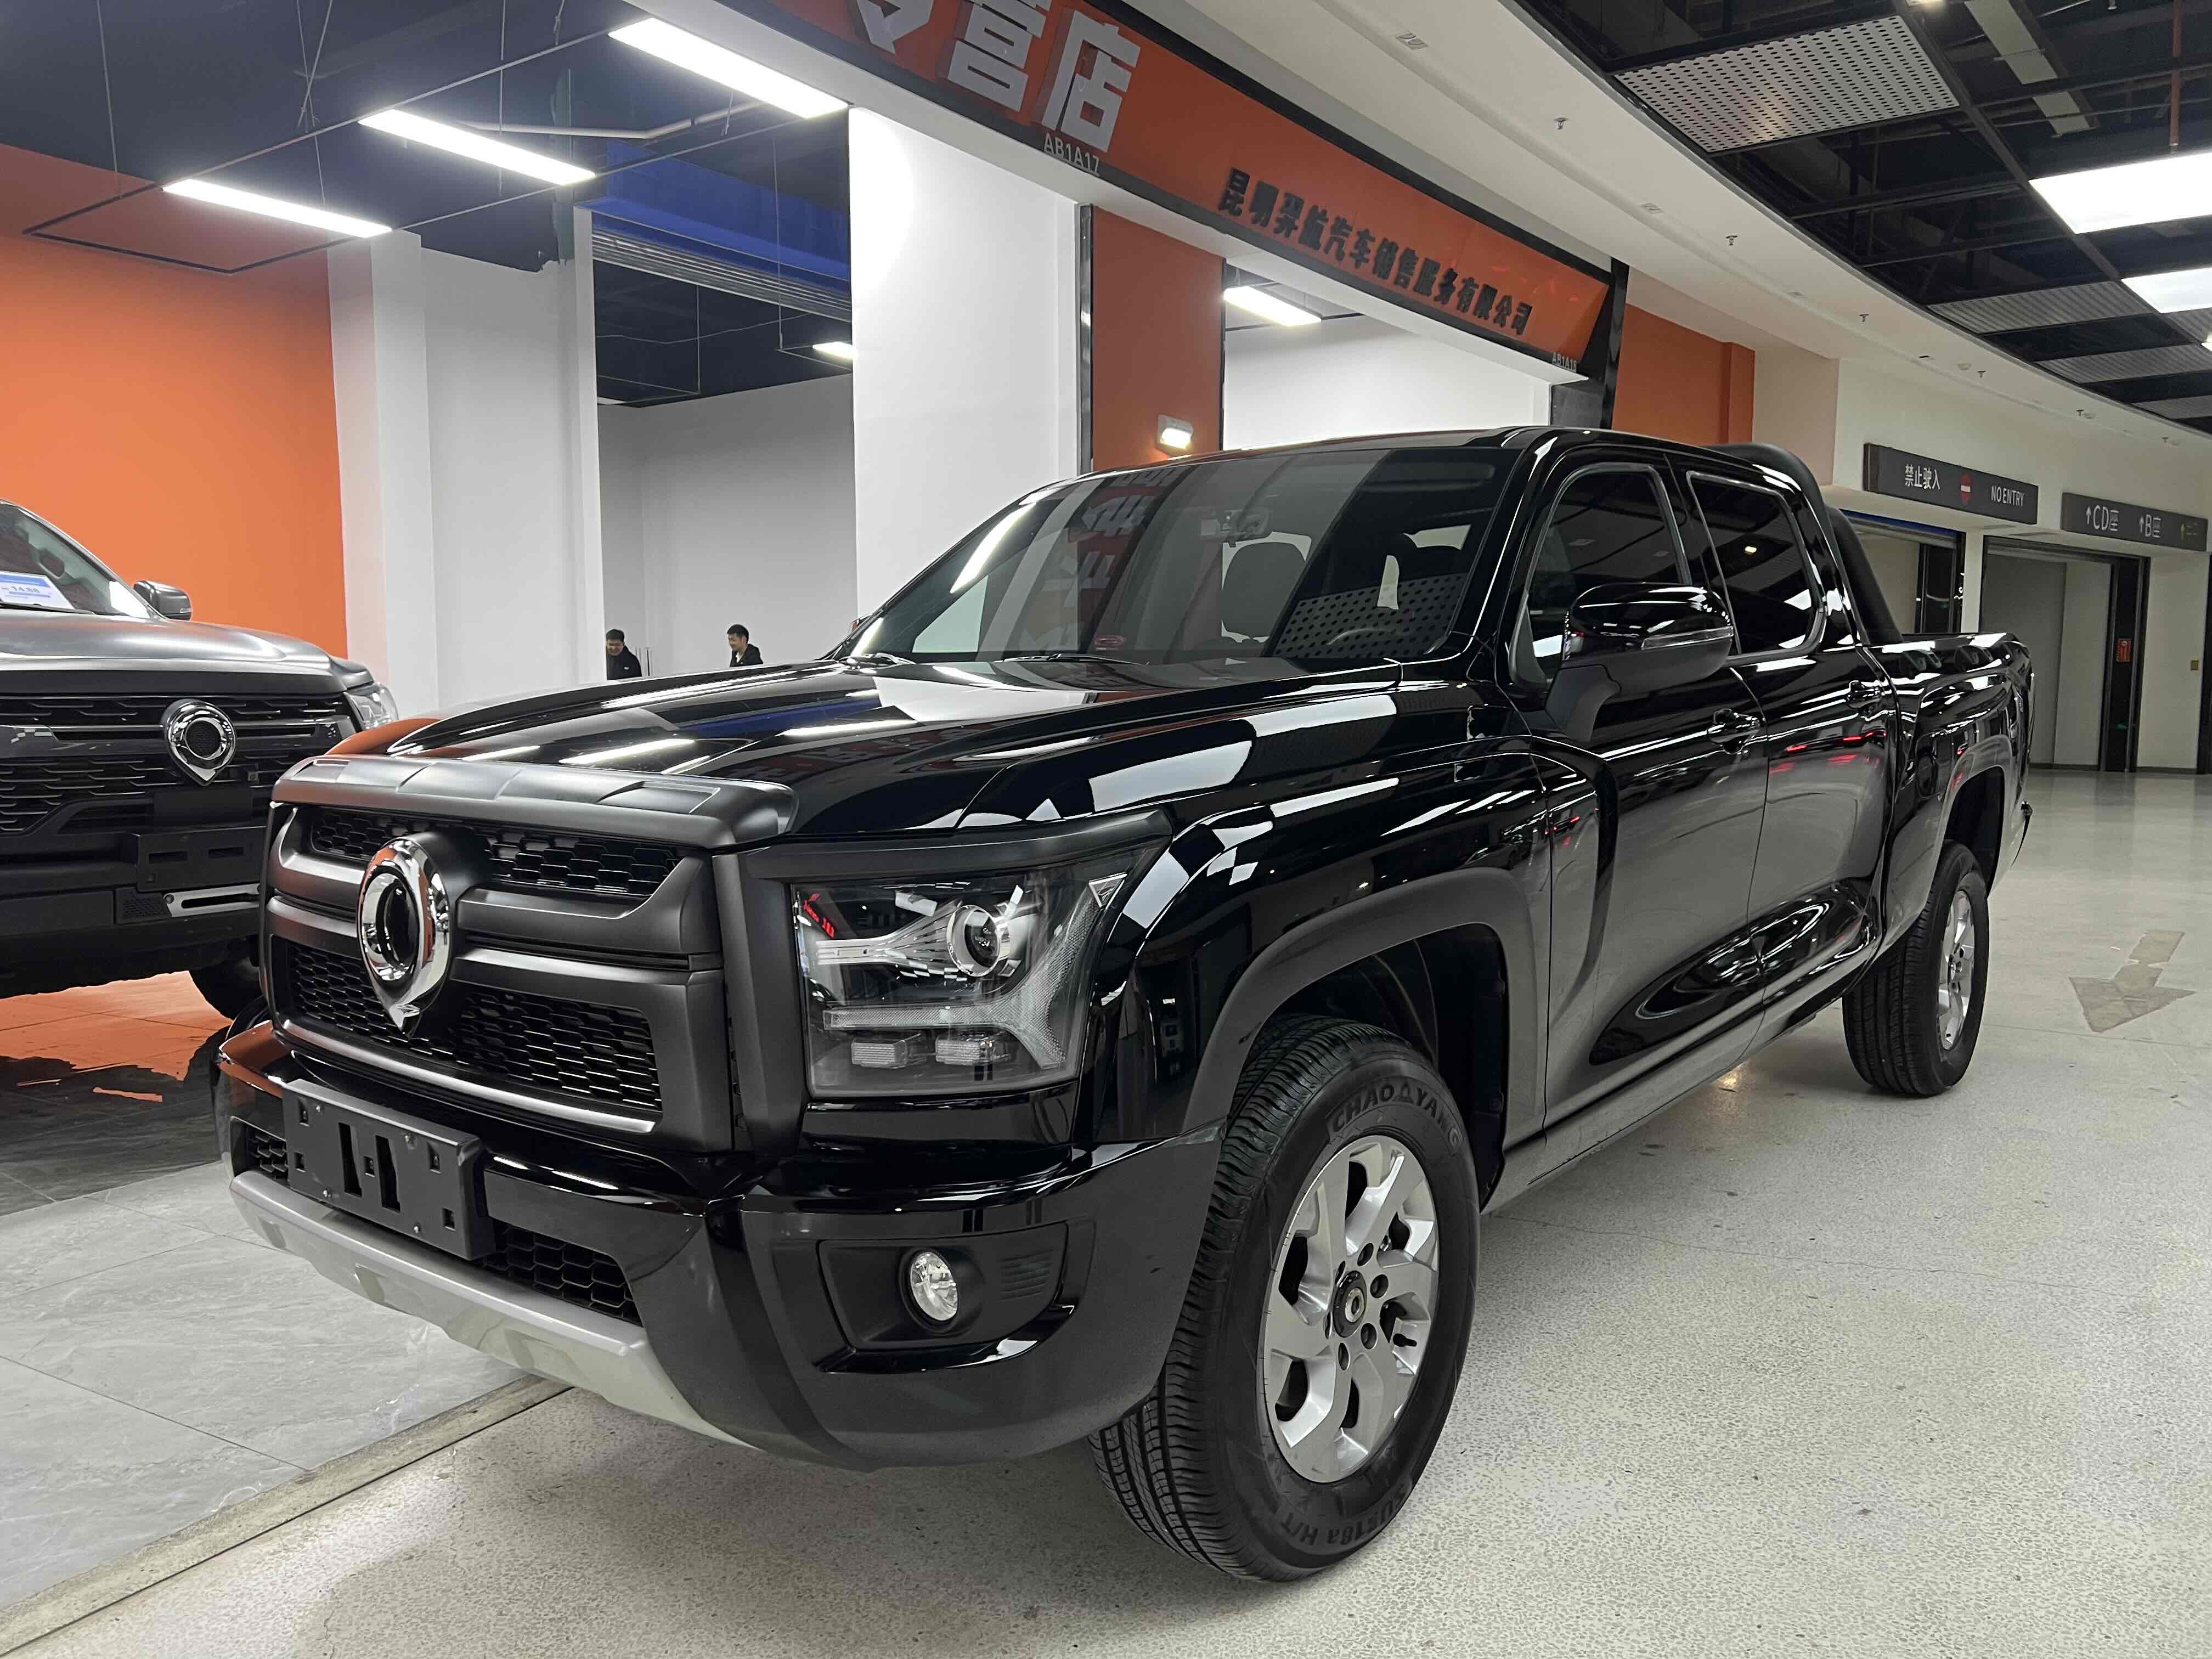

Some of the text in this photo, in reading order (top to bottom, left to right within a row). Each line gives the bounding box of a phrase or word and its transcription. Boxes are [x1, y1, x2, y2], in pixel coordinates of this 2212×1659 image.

[1044, 132, 1099, 174] AB1A17
[1905, 464, 1940, 490] 禁止驶入
[1991, 485, 2025, 507] NO ENTRY
